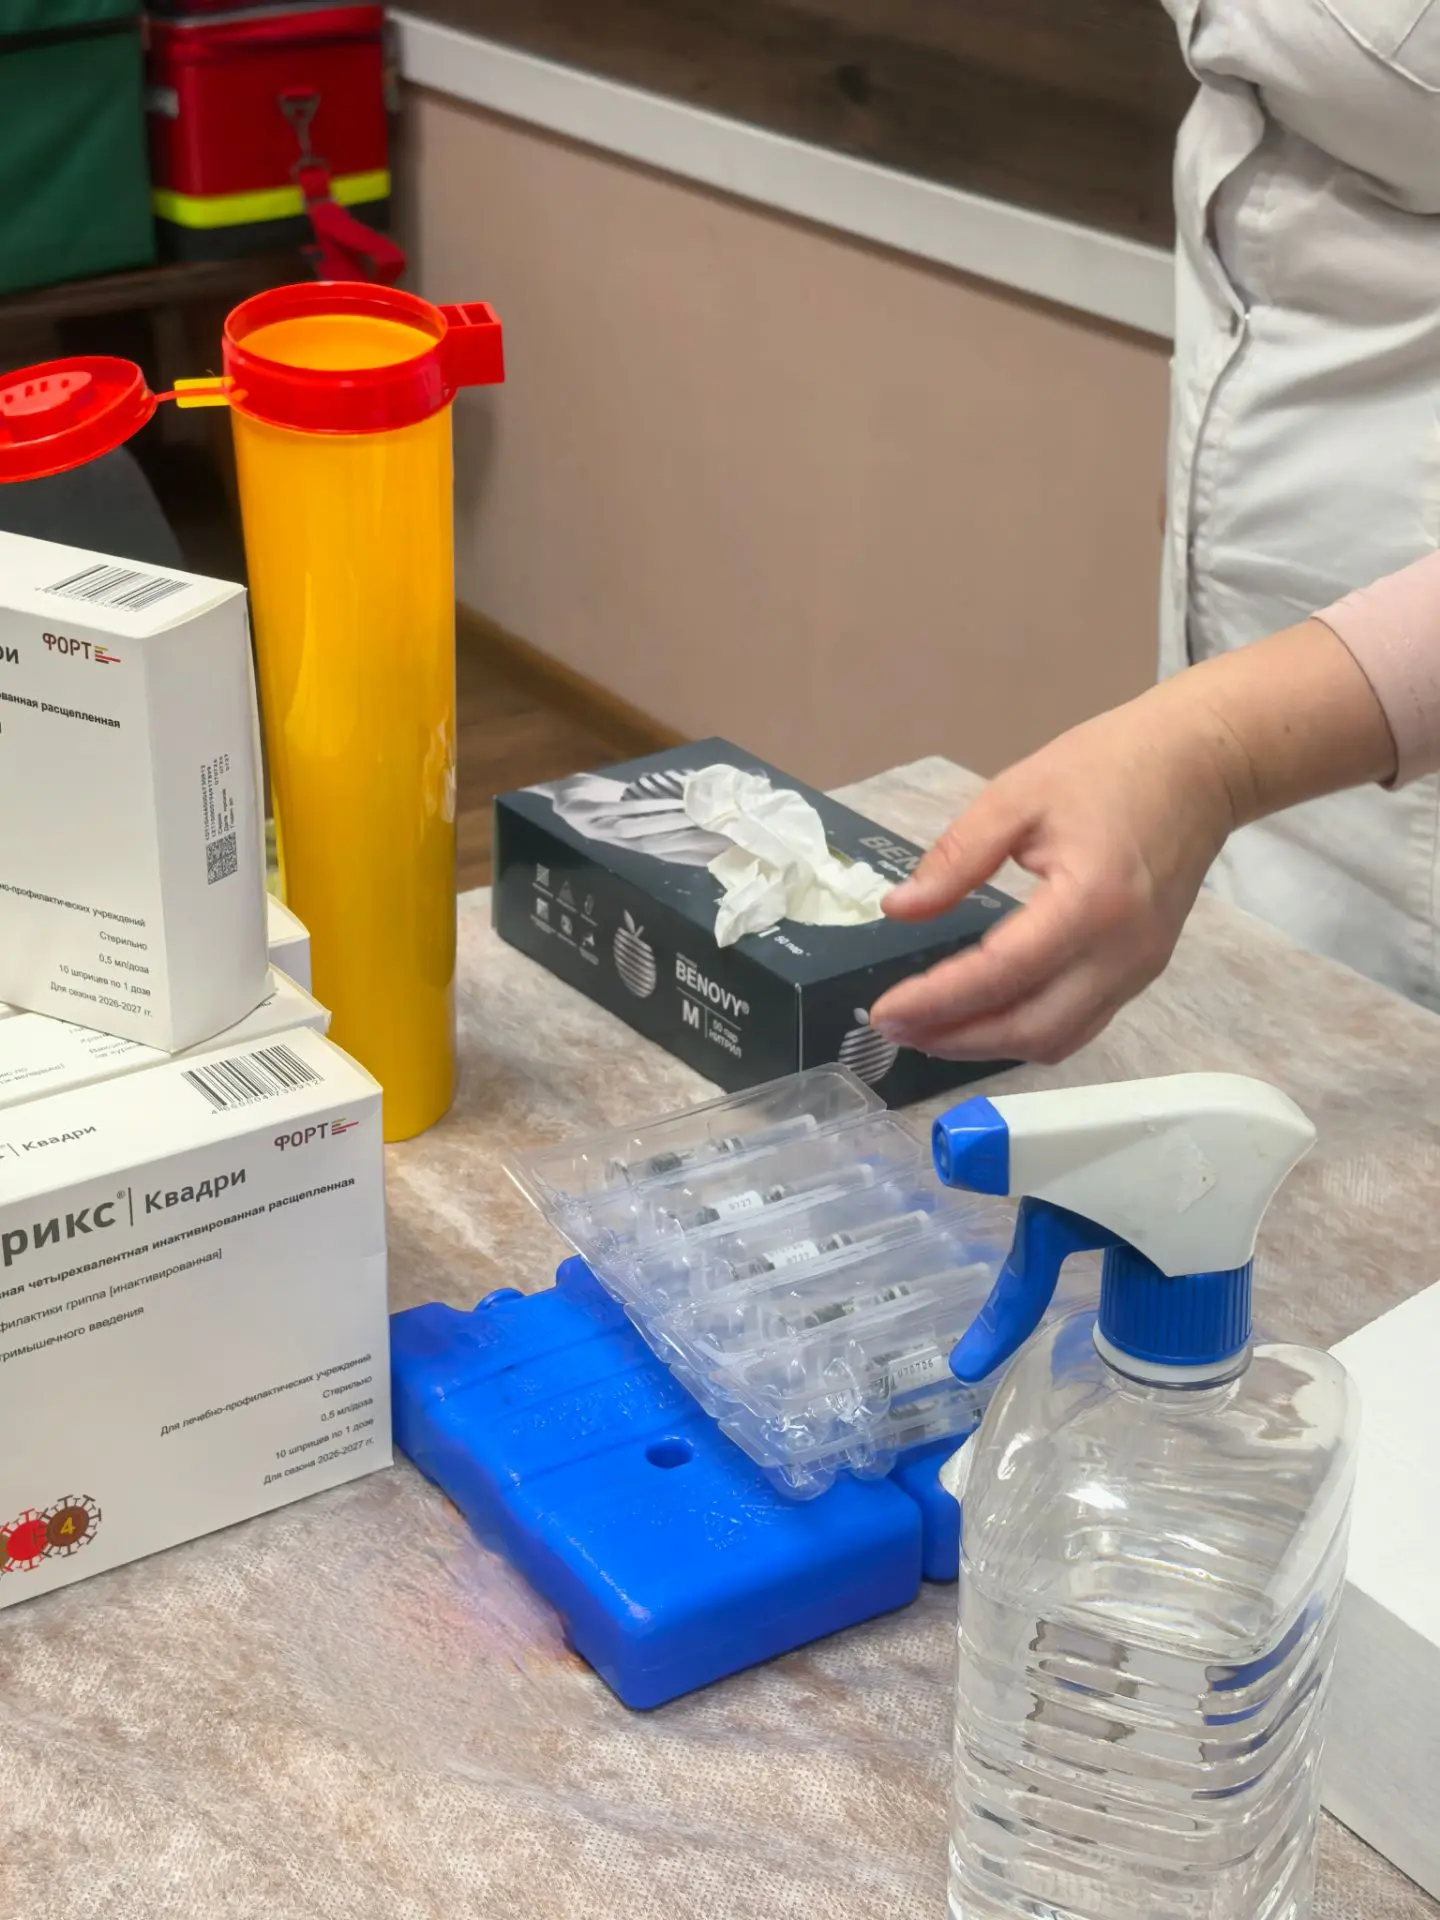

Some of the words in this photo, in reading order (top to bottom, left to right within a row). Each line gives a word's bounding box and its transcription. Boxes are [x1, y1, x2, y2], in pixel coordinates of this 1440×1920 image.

[42, 632, 92, 660] ФОРТ
[0, 692, 39, 709] ванная
[41, 702, 121, 729] расщепленная
[92, 907, 146, 928] учреждений
[99, 930, 148, 951] Стерильно
[98, 952, 113, 966] 0,5
[58, 963, 70, 975] 10
[71, 968, 109, 986] шприцев
[110, 979, 122, 989] по
[123, 981, 129, 991] 1
[130, 984, 151, 997] дозе
[50, 980, 67, 992] Для
[68, 987, 98, 1002] сезона
[98, 995, 142, 1014] 2026-2027
[22, 1126, 97, 1151] Квадри
[274, 1122, 329, 1151] ФОРТ
[145, 1168, 246, 1214] Квадри
[0, 1284, 25, 1300] ная
[28, 1244, 149, 1290] четырехвалентная
[152, 1205, 266, 1250] инактивированная
[268, 1177, 356, 1212] расщепленная
[66, 1290, 107, 1310] гриппа
[109, 1249, 223, 1297] [инактивированная]
[88, 1306, 144, 1332] введения
[160, 1420, 181, 1437] Для
[315, 1353, 372, 1381] учреждений
[322, 1374, 373, 1399] Стерильно
[288, 1435, 330, 1457] шприцев
[331, 1430, 343, 1440] по
[352, 1417, 374, 1433] дозе
[263, 1473, 283, 1486] Для
[60, 1517, 76, 1534] 4
